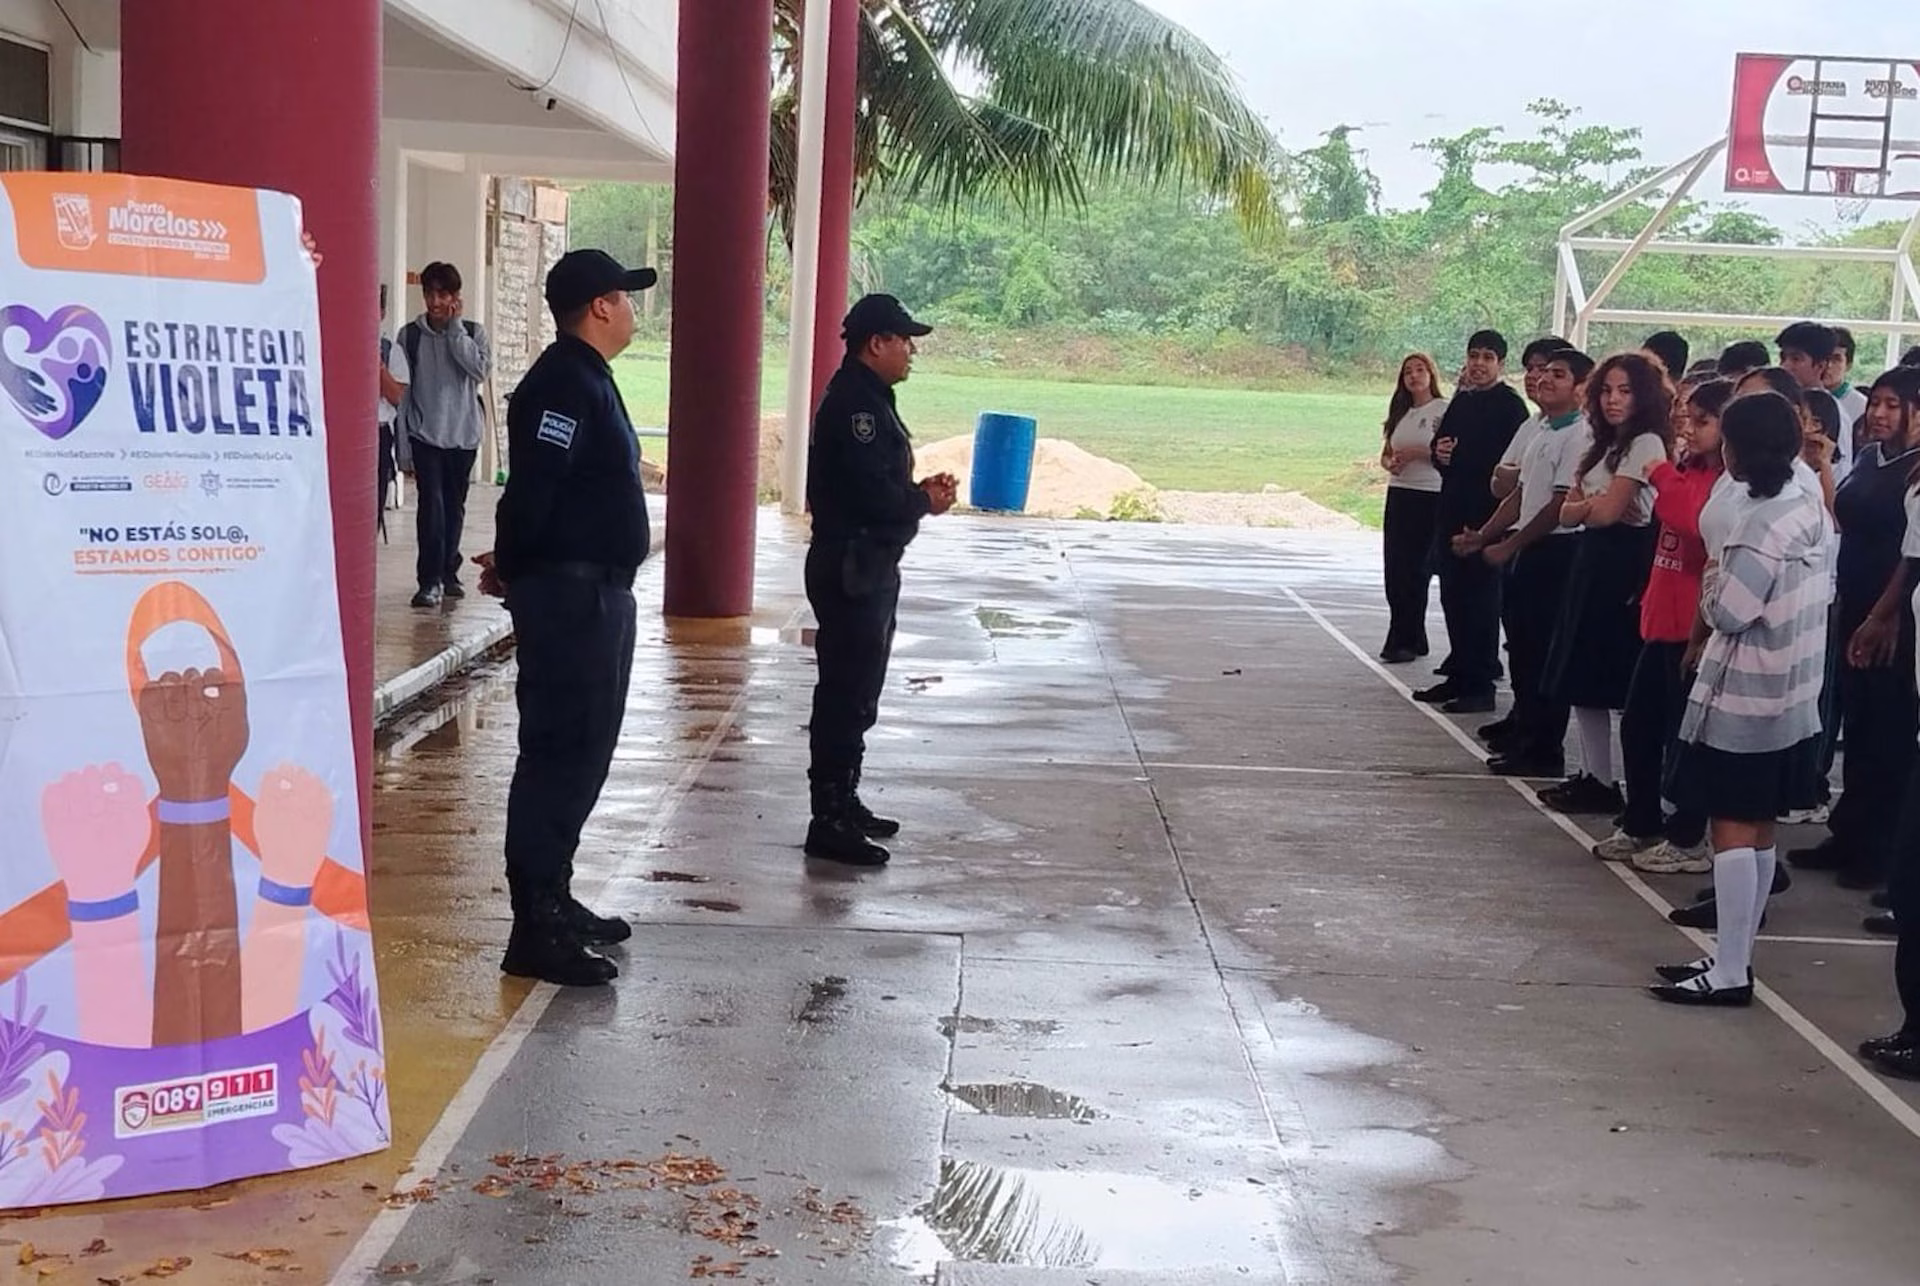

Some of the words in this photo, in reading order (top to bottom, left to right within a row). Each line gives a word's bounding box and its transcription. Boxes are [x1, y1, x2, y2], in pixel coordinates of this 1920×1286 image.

[127, 199, 166, 214] Puerto
[109, 206, 200, 237] Morelos
[124, 320, 306, 366] ESTRATEGIA
[126, 362, 312, 436] VIOLETA
[80, 527, 119, 542] "NO
[126, 521, 186, 541] ESTÁS
[191, 525, 249, 543] SOL@,
[74, 547, 170, 564] ESTAMOS
[177, 546, 265, 562] CONTIGO"
[154, 1085, 199, 1113] 089
[209, 1072, 268, 1099] 911
[207, 1099, 275, 1118] EMERGENCIAS
